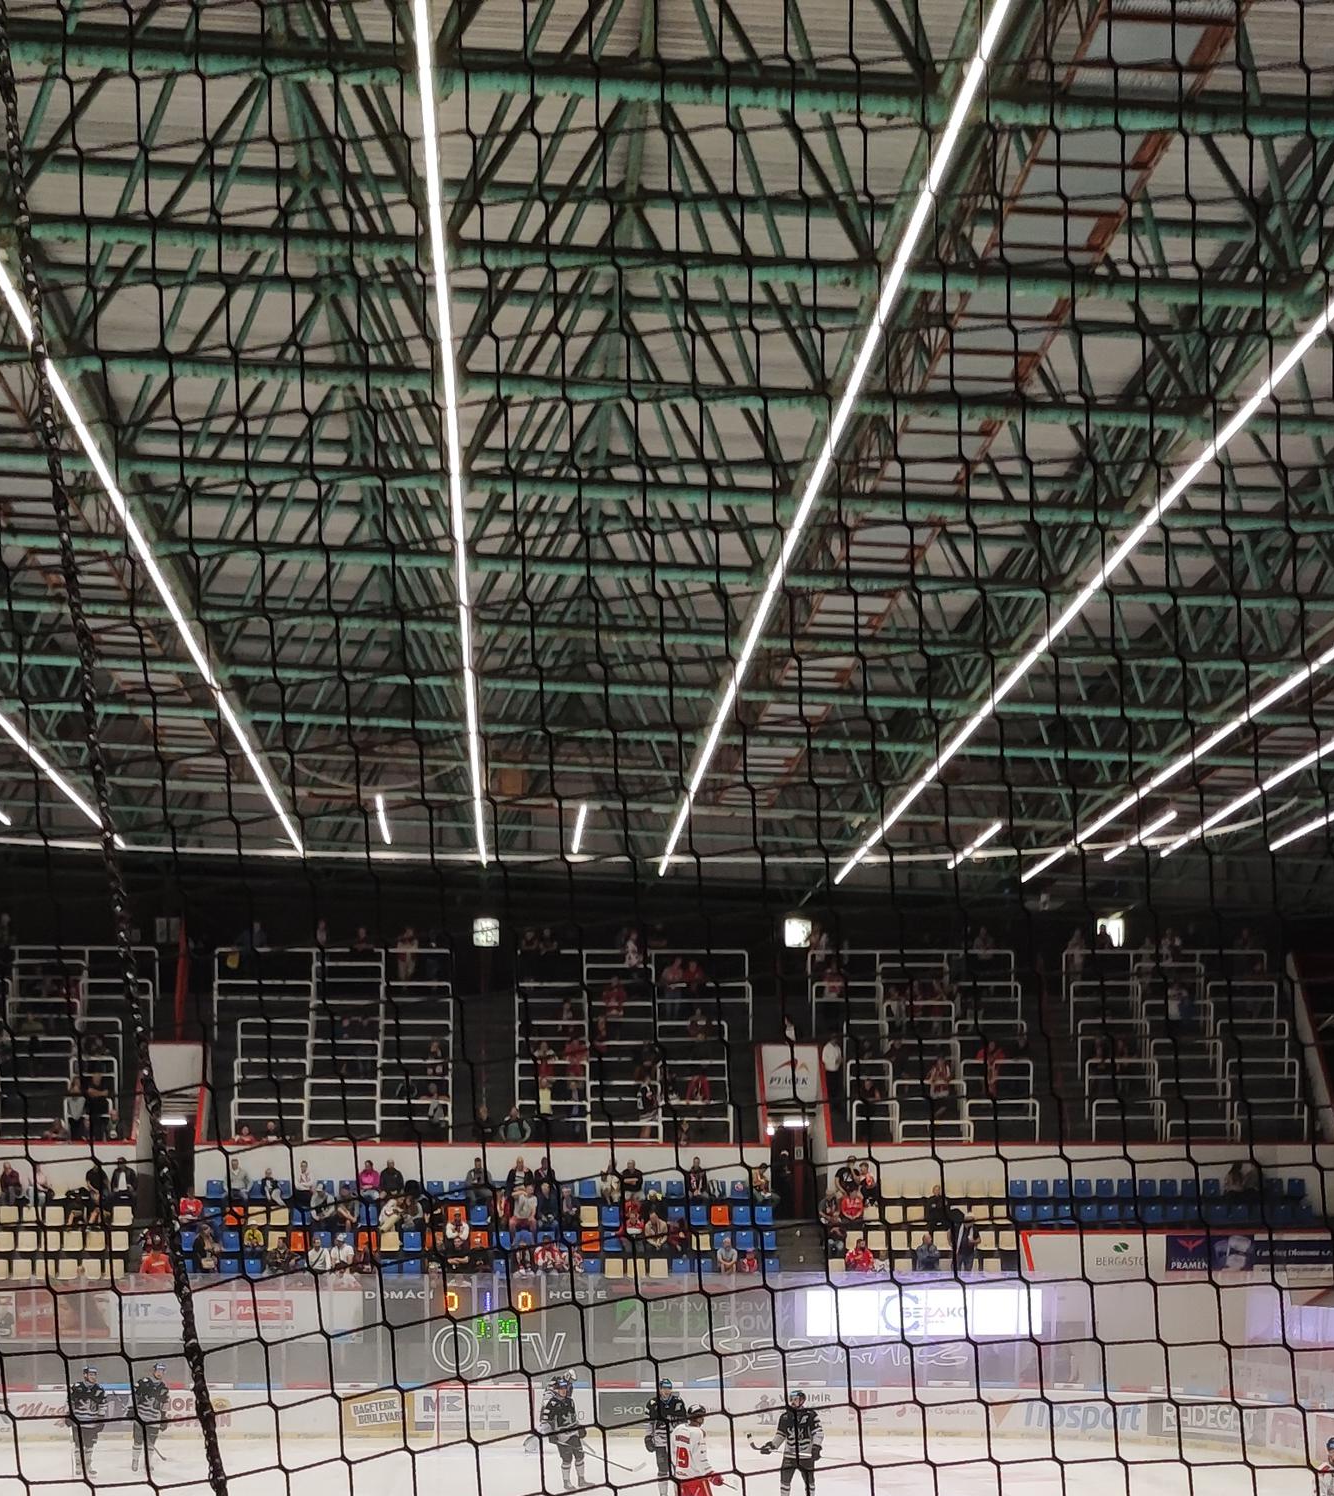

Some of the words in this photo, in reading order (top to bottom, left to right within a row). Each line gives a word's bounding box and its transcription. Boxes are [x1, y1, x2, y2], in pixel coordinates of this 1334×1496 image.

[517, 1291, 532, 1312] 0
[498, 1332, 567, 1374] TV
[358, 1410, 404, 1425] BOULEVAR
[1163, 1405, 1259, 1435] RADEGAT
